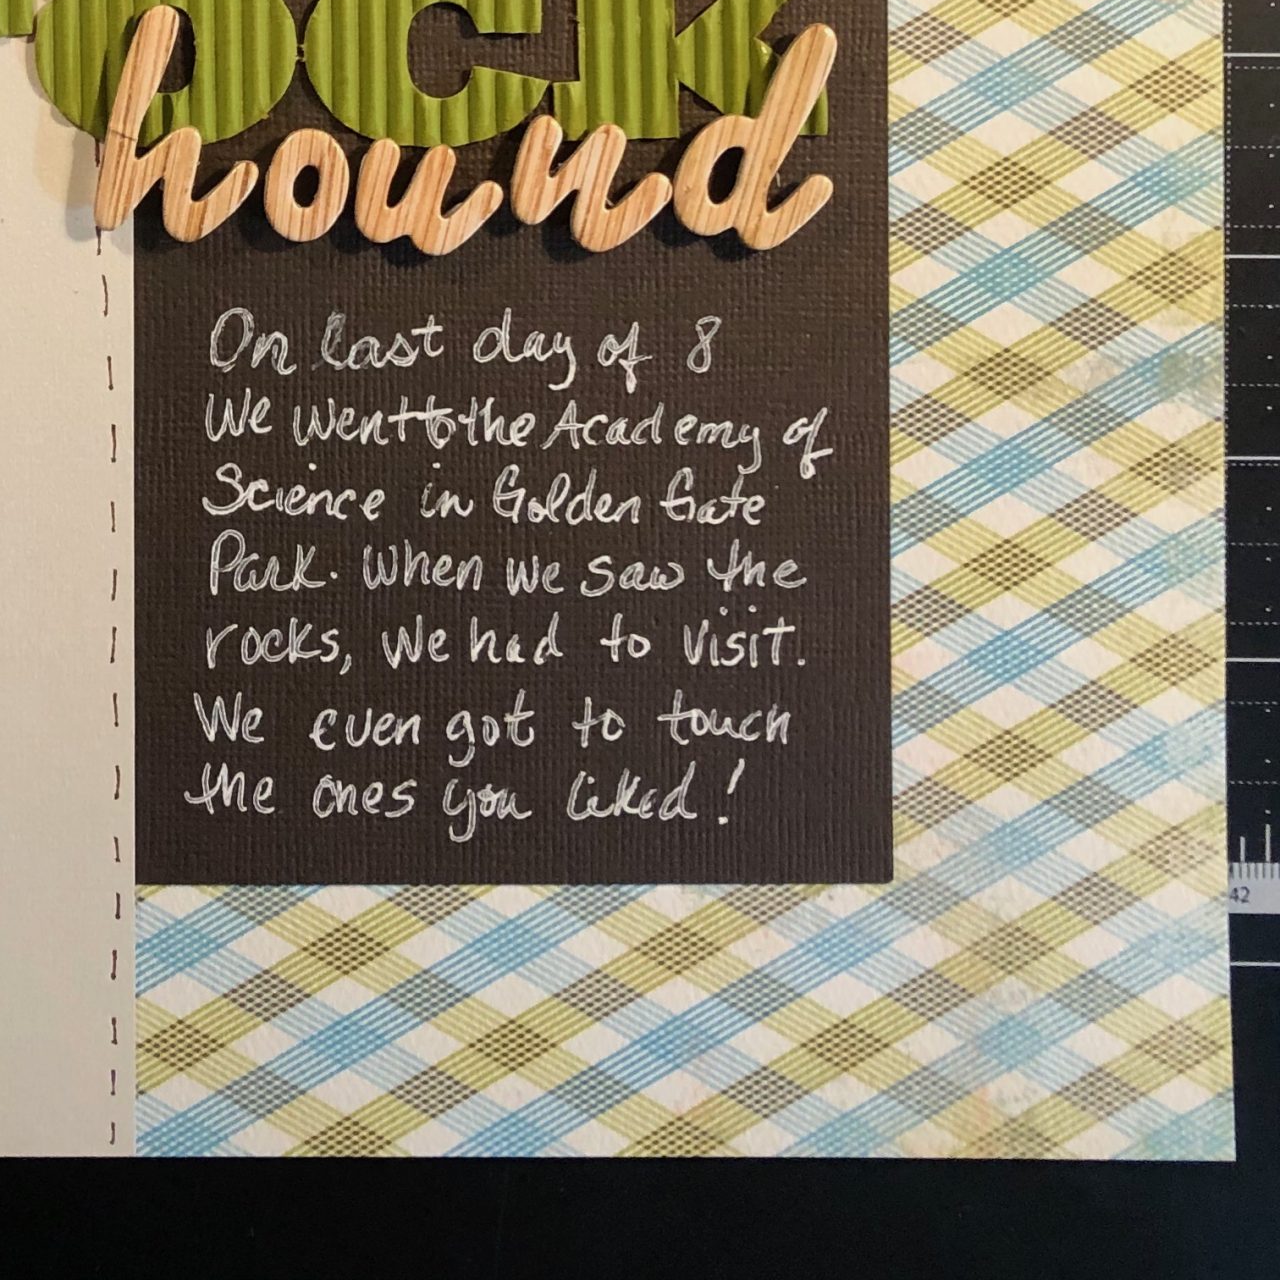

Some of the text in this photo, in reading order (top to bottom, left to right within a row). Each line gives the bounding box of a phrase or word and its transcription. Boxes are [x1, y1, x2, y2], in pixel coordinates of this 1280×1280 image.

[94, 4, 838, 257] hound
[209, 307, 721, 394] On last day of 8
[205, 387, 272, 442] We
[458, 396, 536, 446] the
[540, 400, 762, 474] Academy
[782, 407, 834, 479] of
[202, 461, 767, 526] Science in Golden Gate
[210, 529, 338, 596] Park.
[580, 555, 685, 598] saw
[706, 538, 808, 592] the
[206, 617, 352, 675] rocks,
[470, 611, 564, 666] had
[600, 612, 651, 663] to
[193, 688, 792, 768] We even got to touch
[183, 762, 276, 815] the
[312, 774, 418, 819] ones
[442, 777, 532, 843] you
[1229, 885, 1251, 904] 42
